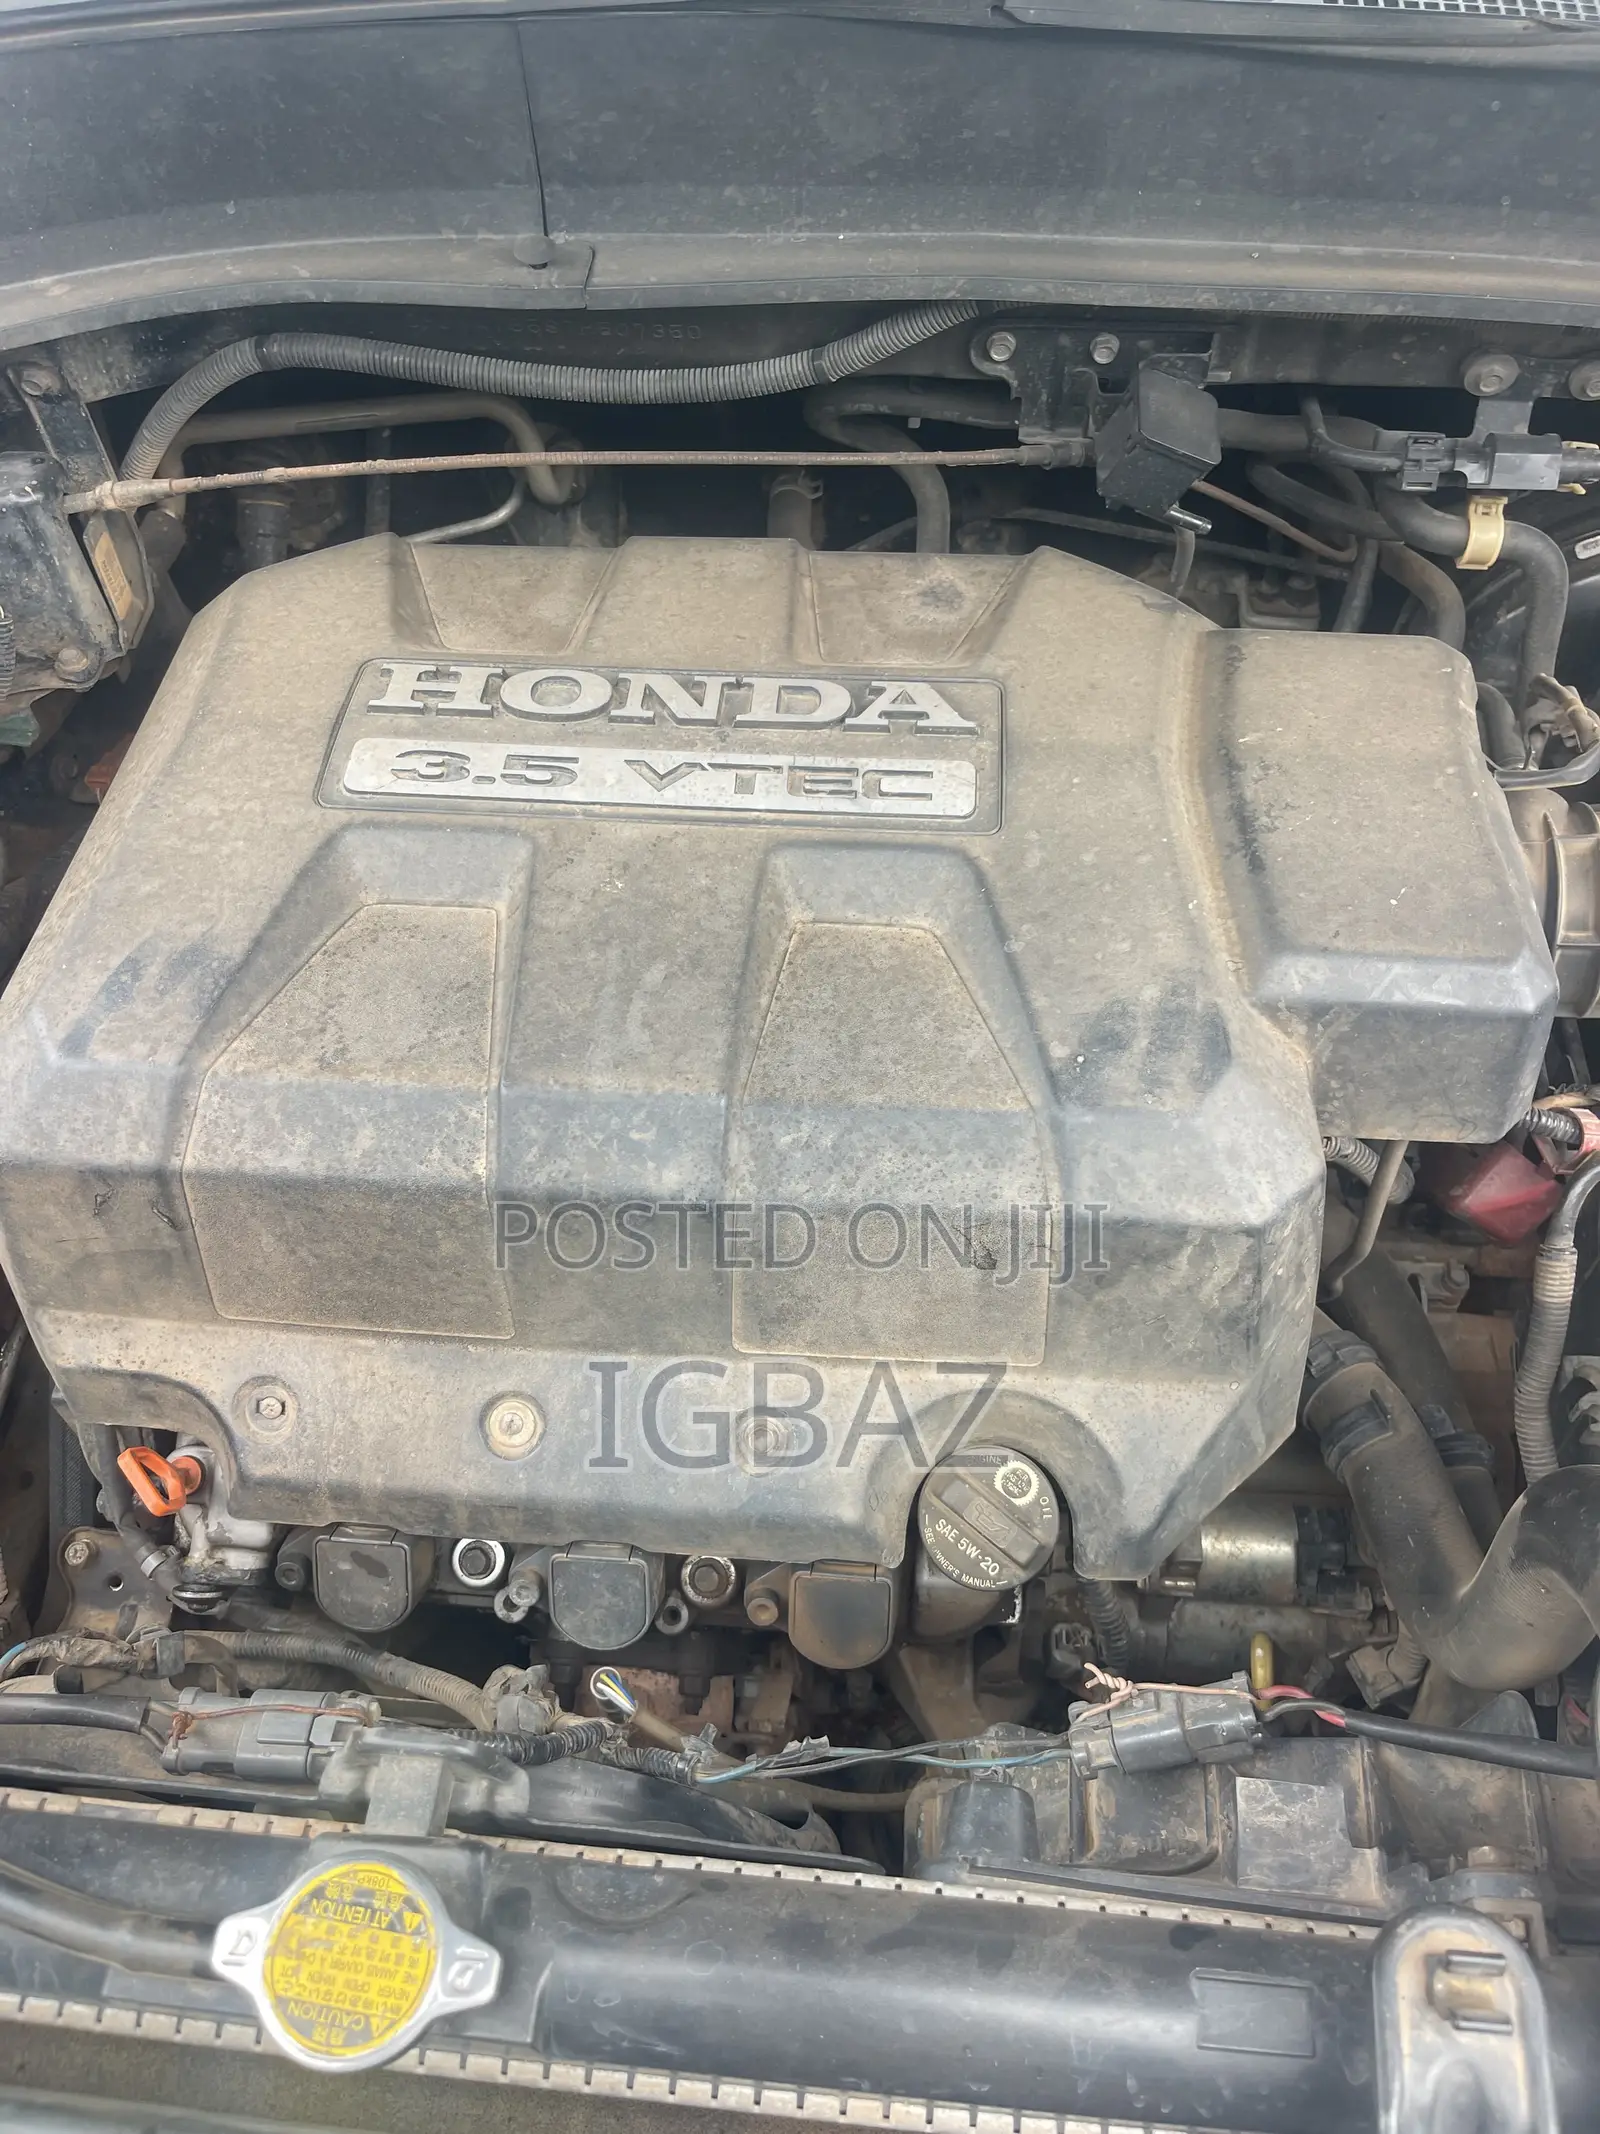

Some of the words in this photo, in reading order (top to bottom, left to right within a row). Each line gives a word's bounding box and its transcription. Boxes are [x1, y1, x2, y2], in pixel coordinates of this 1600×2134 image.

[366, 662, 979, 736] HONDA
[391, 750, 580, 788] 3.5
[624, 760, 934, 801] VTEC
[1039, 1496, 1053, 1520] OIL
[923, 1527, 936, 1545] SEE
[961, 1574, 996, 1589] MANUAL
[935, 1519, 959, 1543] SAE
[958, 1537, 1000, 1576] 5W-20
[310, 1899, 392, 1928] ATTENTION
[342, 1975, 370, 1994] OPEN
[378, 1981, 410, 2001] NEVER
[287, 2001, 365, 2029] CAUTION
